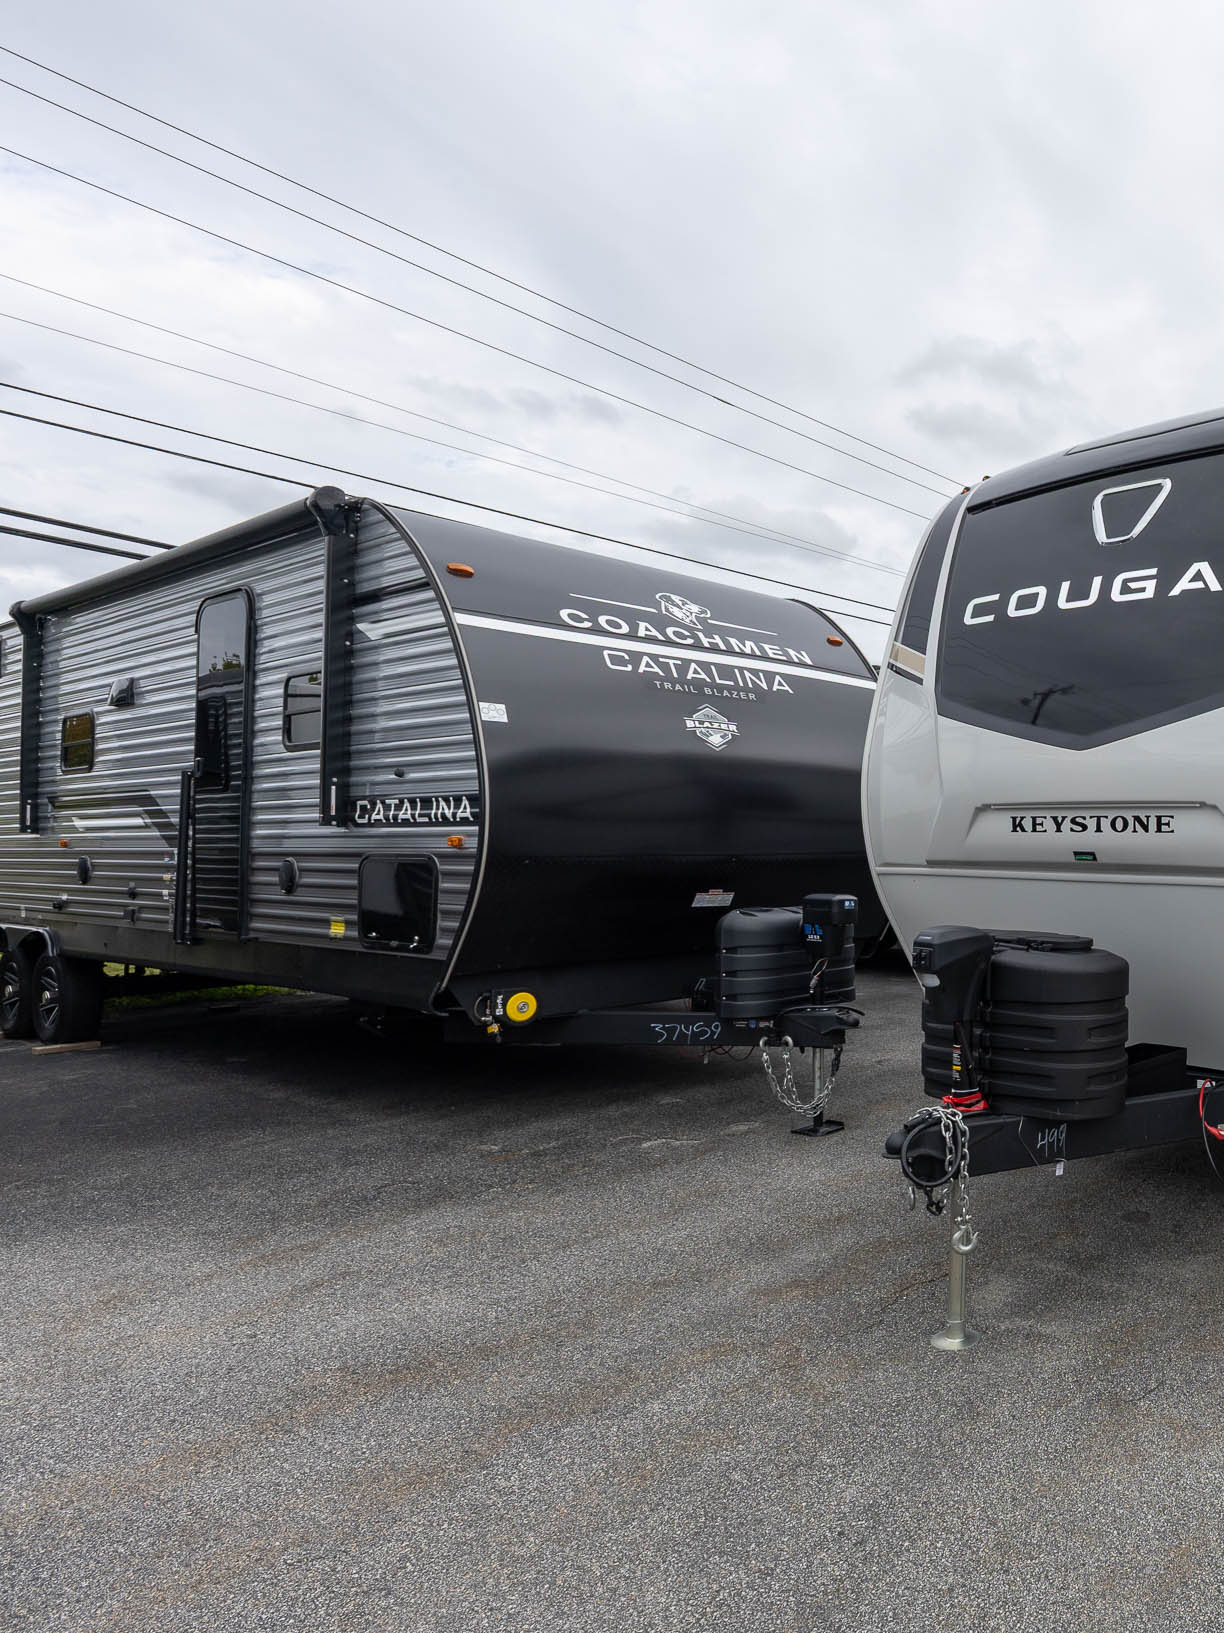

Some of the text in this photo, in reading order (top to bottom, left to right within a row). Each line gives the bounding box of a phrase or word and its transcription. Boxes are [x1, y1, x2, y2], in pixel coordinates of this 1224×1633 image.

[559, 608, 813, 665] COACHMEN
[603, 650, 794, 694] CATALINA
[654, 681, 757, 701] TRAIL BLAZER
[685, 719, 739, 732] BLAZER
[355, 796, 474, 823] CATALINA
[1010, 815, 1175, 833] KEYSTONE
[650, 1021, 722, 1045] 37459
[1036, 1123, 1067, 1158] 499
